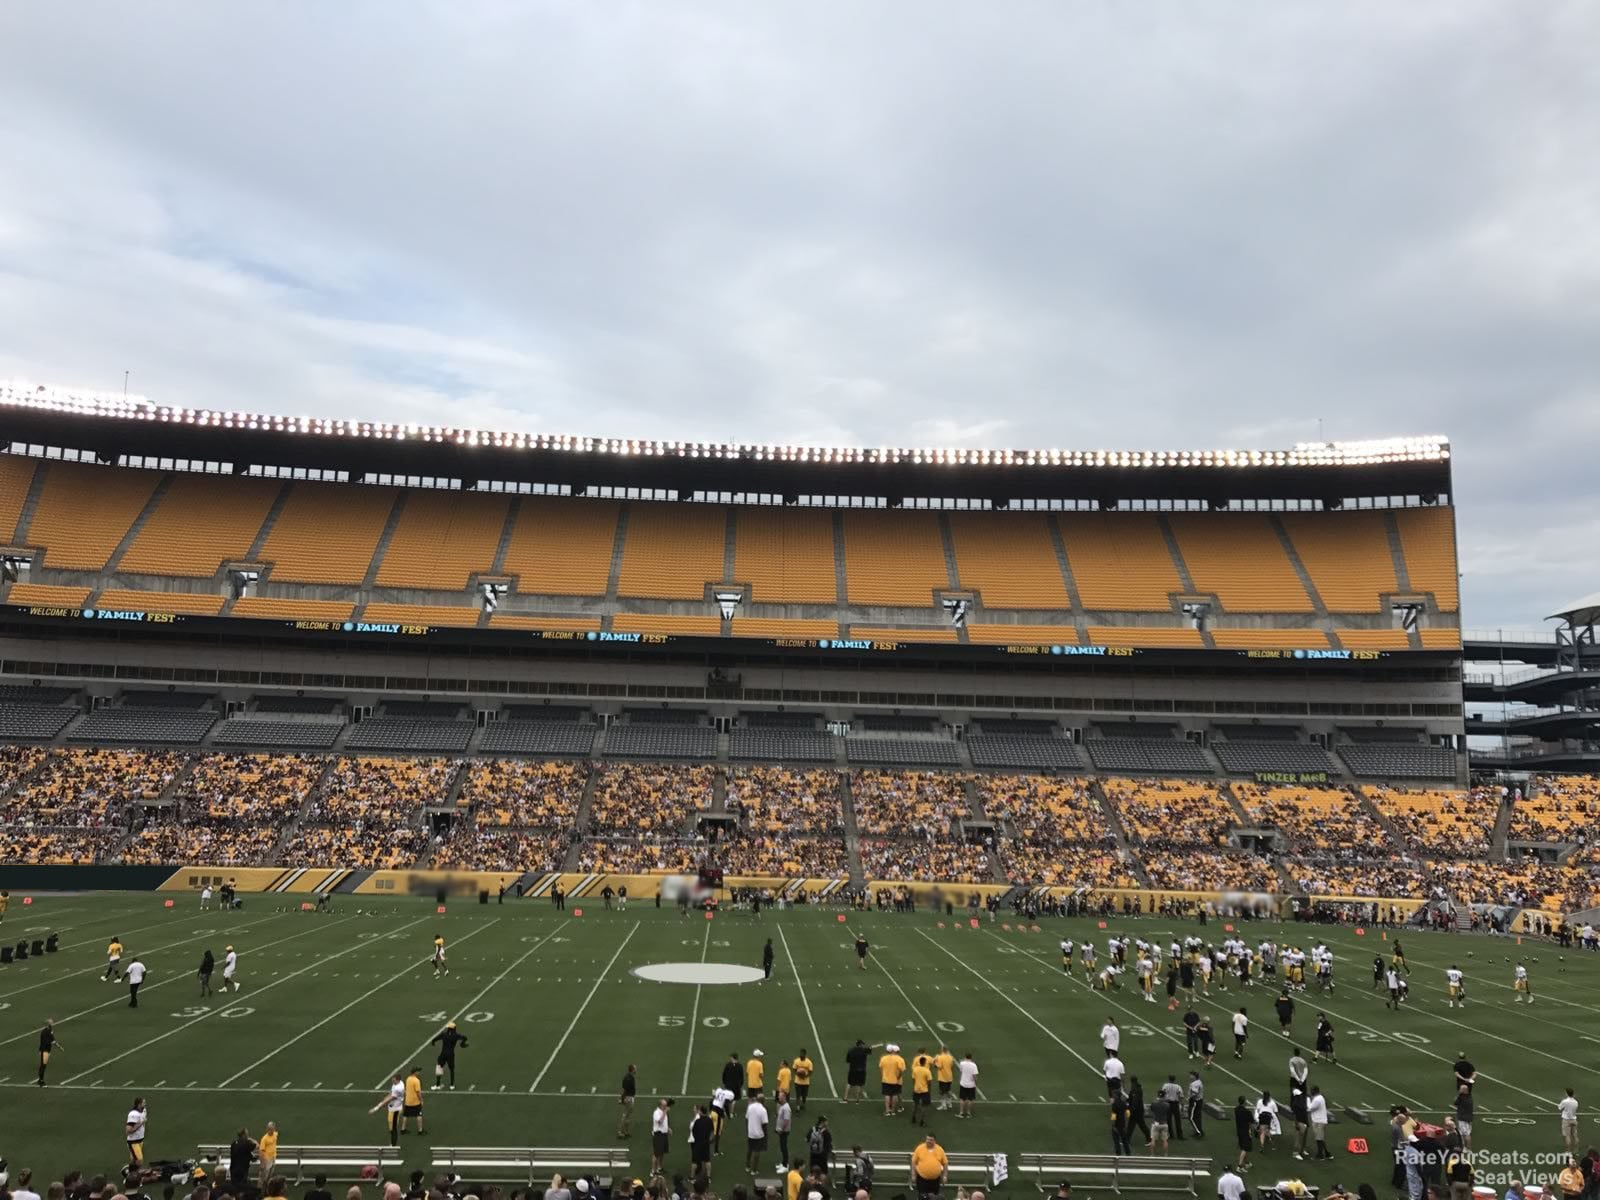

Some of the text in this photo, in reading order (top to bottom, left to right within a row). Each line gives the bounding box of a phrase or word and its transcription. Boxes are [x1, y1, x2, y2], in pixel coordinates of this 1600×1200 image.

[29, 607, 176, 623] WELCOME TO FAMILY FEST
[295, 621, 429, 635] WELCOME TO FAMILY FEST
[542, 631, 668, 644] WELCOME TO FAMILY FEST
[775, 639, 898, 650] WELCOME TO FAMILY FEST
[1007, 645, 1134, 656] WELCOME TO FAMILY FEST
[1248, 650, 1380, 659] WELCOME TO FAMILY FEST
[1255, 772, 1297, 782] YINZER
[658, 1016, 730, 1027] 50
[896, 1021, 965, 1032] 40
[1346, 1031, 1432, 1043] 20
[1353, 1140, 1366, 1151] 30
